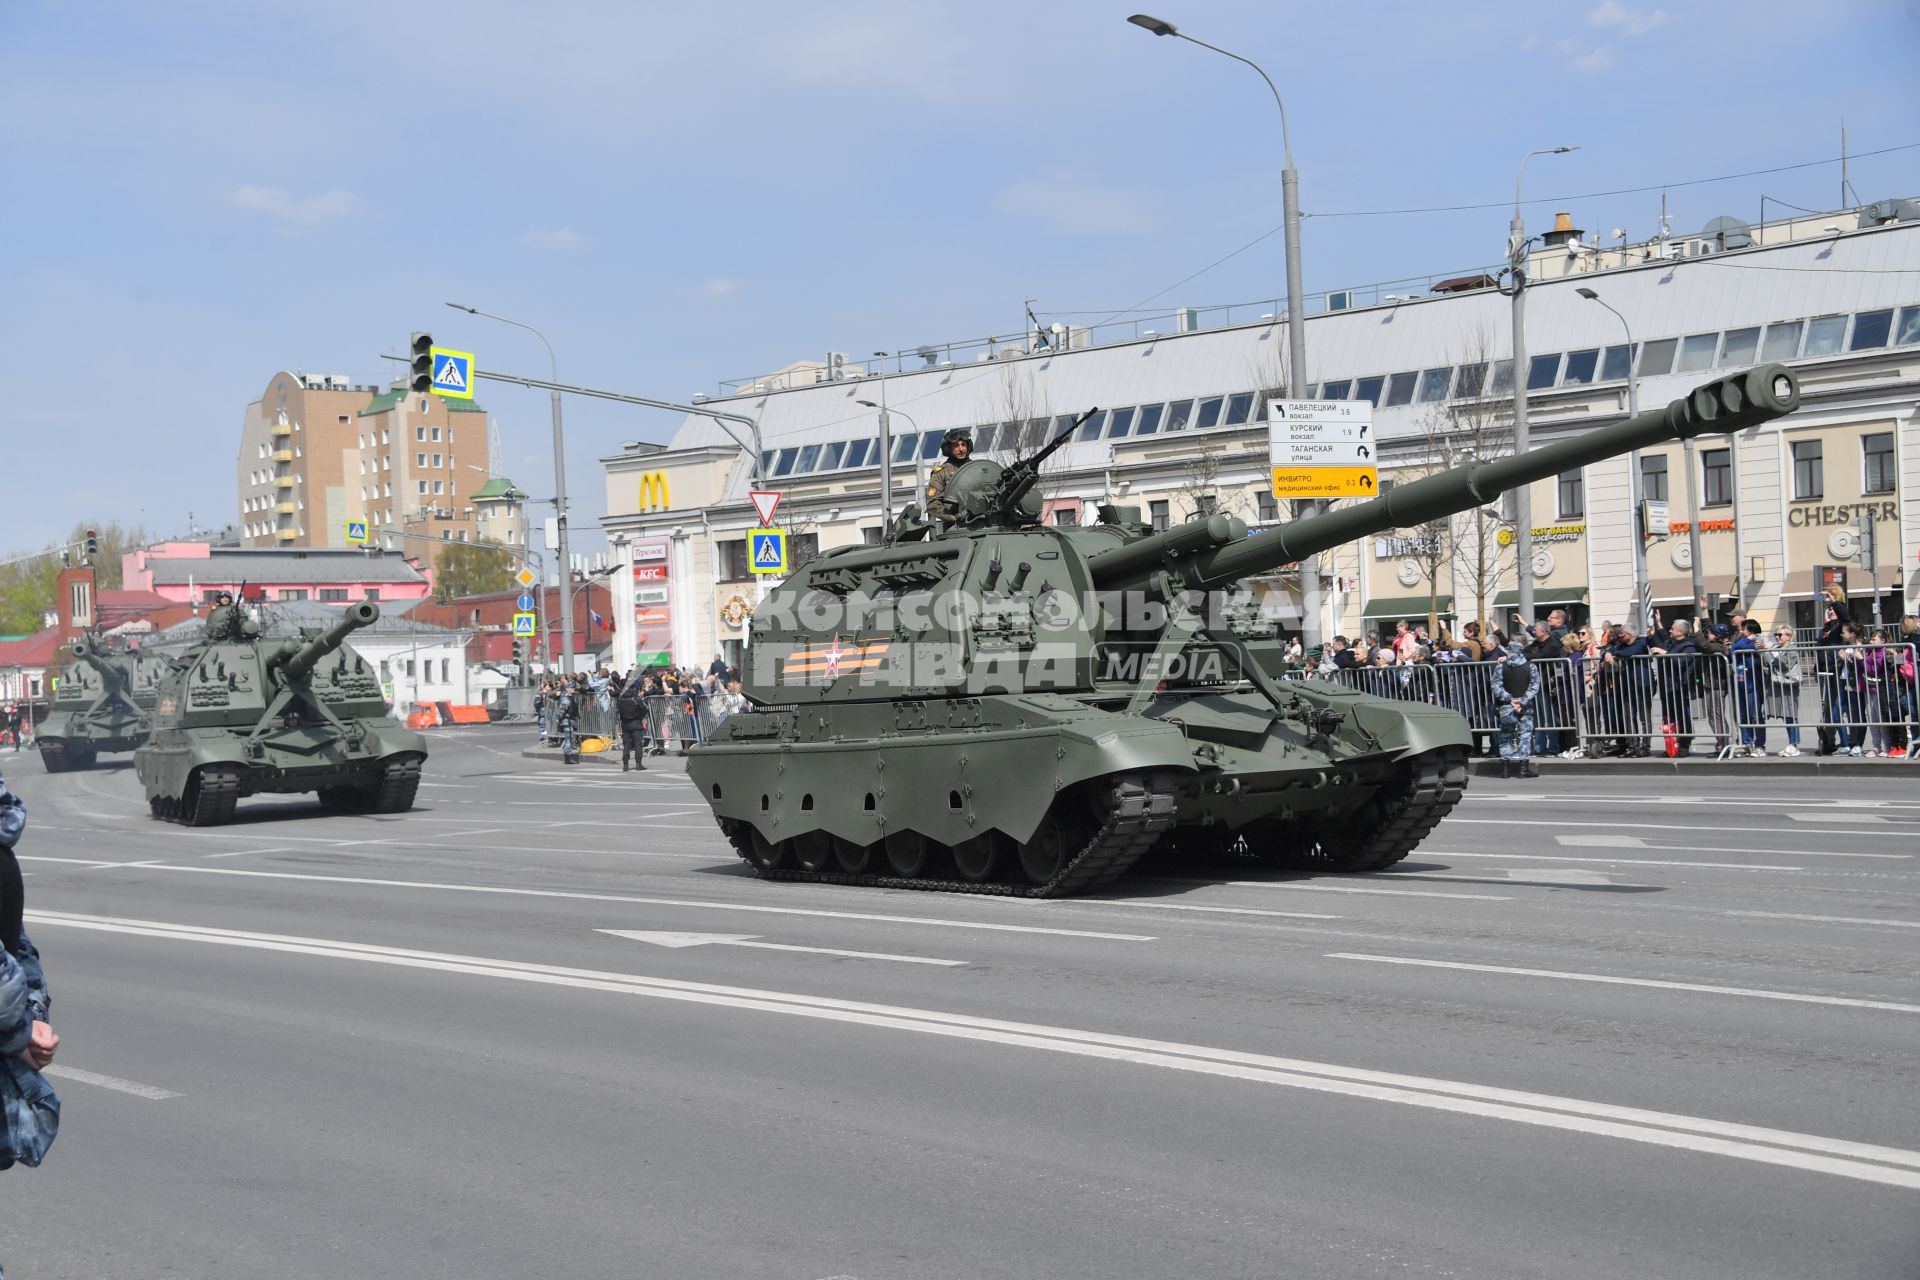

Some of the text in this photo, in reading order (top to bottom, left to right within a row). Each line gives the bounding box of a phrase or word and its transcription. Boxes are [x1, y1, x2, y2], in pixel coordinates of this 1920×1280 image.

[1288, 402, 1337, 412] ПАВЕЛЕЦКИЙ
[1340, 408, 1351, 416] 3.6
[1289, 424, 1323, 432] КУРСКИЙ
[1291, 445, 1333, 453] ТАГАНСКАЯ
[1291, 454, 1313, 462] улица
[1277, 475, 1312, 483] ИНВИТРО
[1550, 525, 1586, 535] BAKERY
[639, 568, 660, 580] KFC
